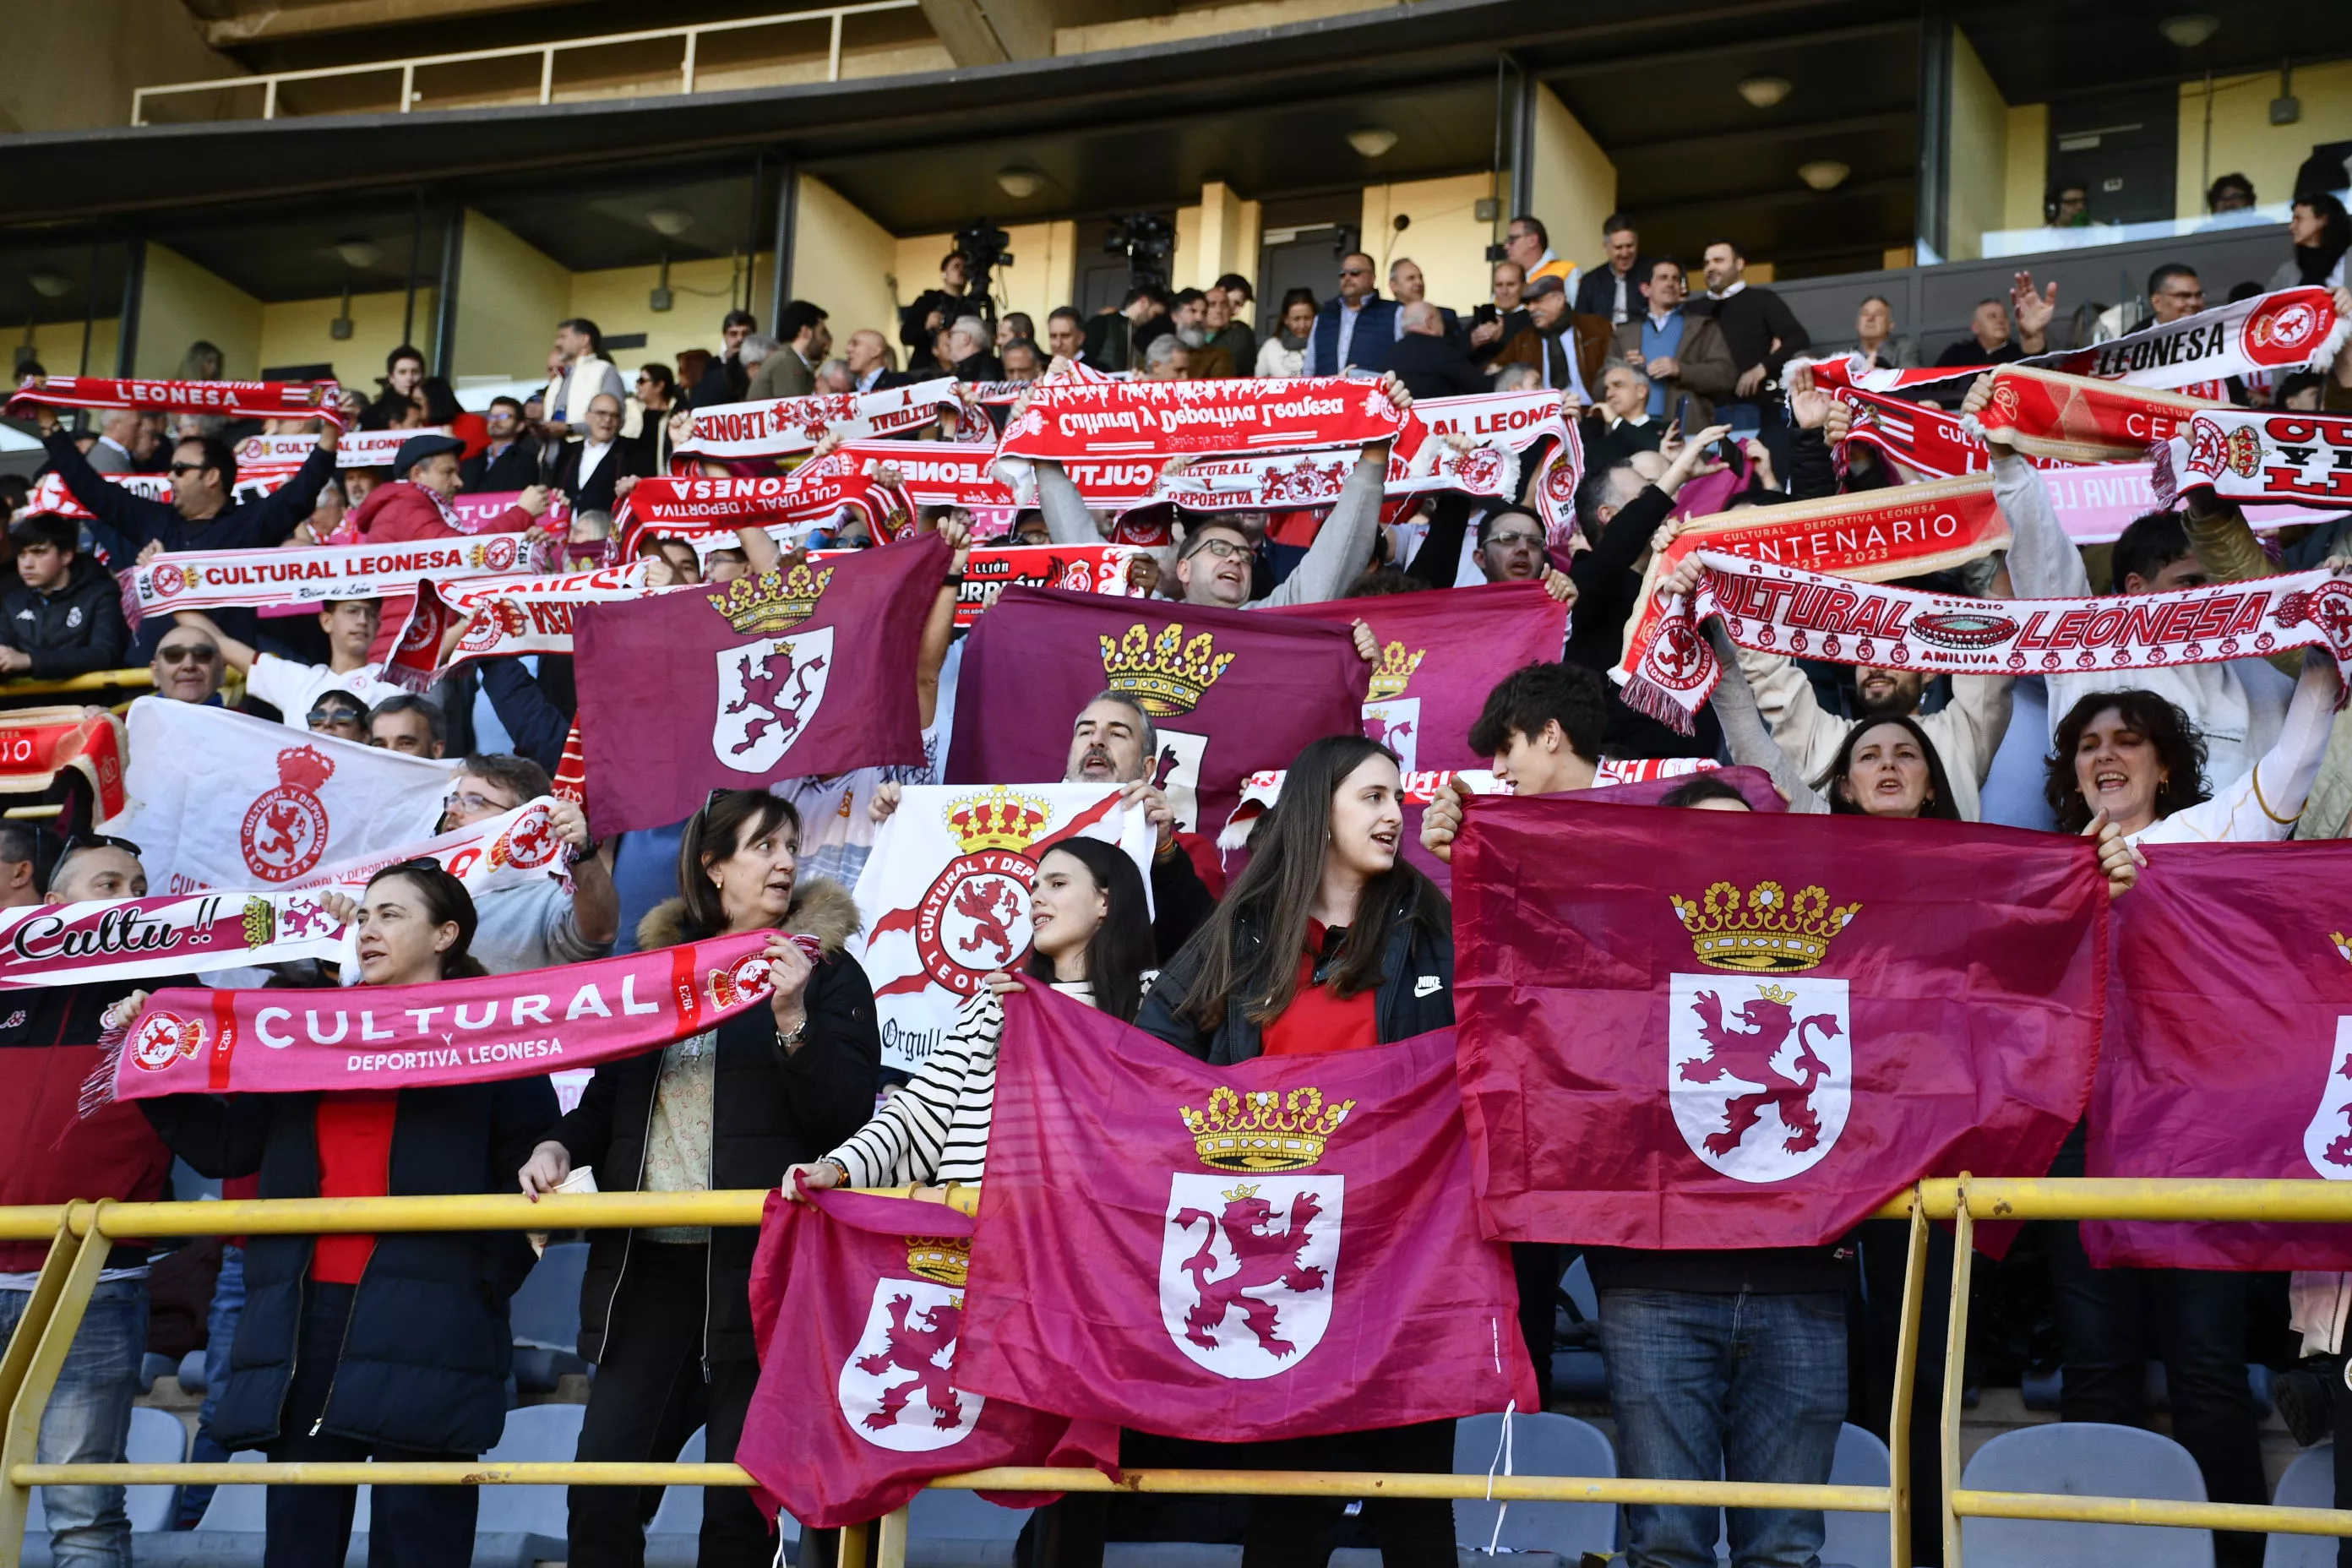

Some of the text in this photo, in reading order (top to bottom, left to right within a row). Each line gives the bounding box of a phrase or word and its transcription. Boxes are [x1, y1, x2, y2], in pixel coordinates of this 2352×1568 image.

[2099, 322, 2224, 375] LEONESA
[116, 384, 240, 406] LEONESA
[694, 401, 939, 442] ULTURAL LEONES
[1475, 403, 1562, 434] LEONE
[1179, 462, 1253, 478] ULTURAL
[651, 503, 741, 517] DEPORTIVA
[758, 484, 841, 511] CULTURAL
[1723, 527, 1787, 542] CULTURAL
[1804, 514, 1874, 531] DEPORTIVA
[1879, 504, 1936, 519] LEONESA
[205, 548, 463, 585] CULTURAL LEONESA
[1844, 547, 1889, 564] 2023
[1932, 598, 2004, 612] ESTADIO
[2012, 591, 2273, 651] LEONESA
[1921, 649, 1999, 665] AMILIVIA
[243, 789, 286, 837] CULTURAL
[298, 792, 326, 856] DEPORTIVA
[920, 859, 979, 943] CULTURAL
[983, 855, 996, 869] Y
[14, 909, 181, 958] Cultu
[1418, 975, 1441, 988] NIKE
[254, 973, 660, 1049] CULTURAL
[681, 983, 694, 1012] 1923
[217, 1029, 233, 1052] 1923
[346, 1037, 564, 1071] DEPORTIVA LEONESA
[441, 1032, 454, 1047] Y
[881, 1016, 942, 1063] Orgull
